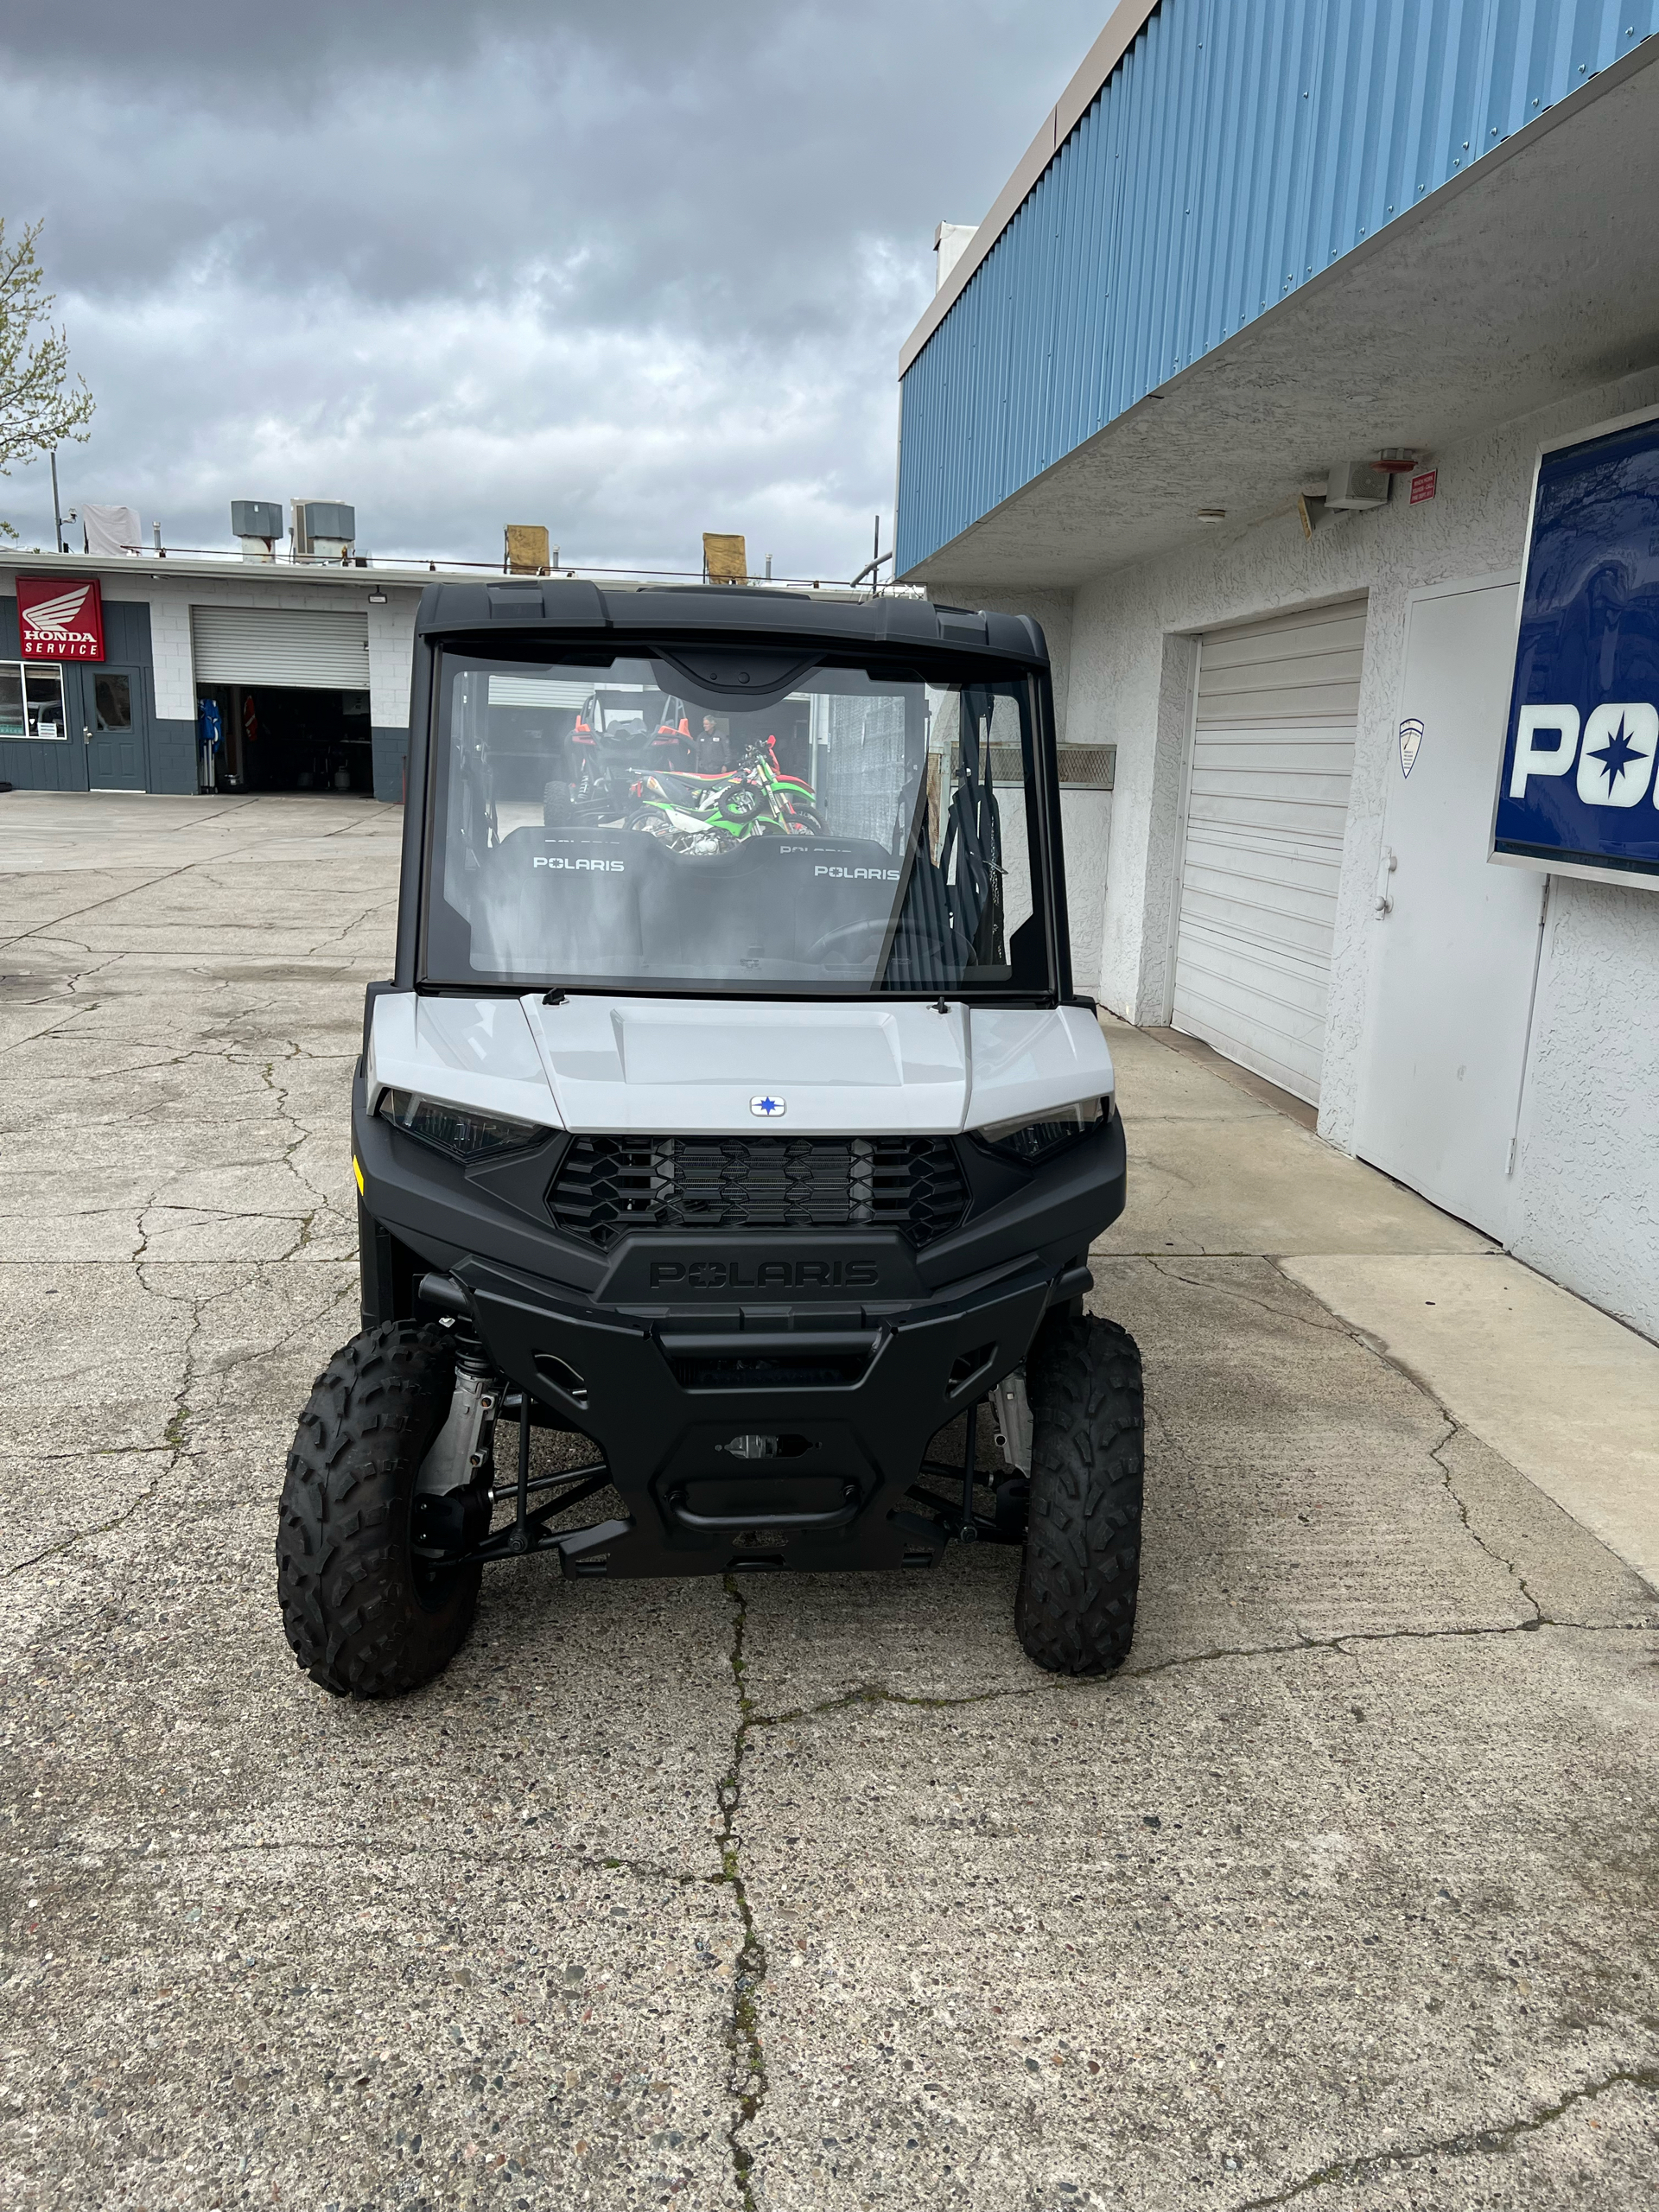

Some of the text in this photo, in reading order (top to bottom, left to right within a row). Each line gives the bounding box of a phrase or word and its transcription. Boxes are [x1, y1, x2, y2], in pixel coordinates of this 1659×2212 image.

[23, 630, 97, 642] HONDA
[25, 642, 98, 655] SERVICE
[1510, 702, 1659, 810] PO
[533, 856, 625, 872] POLARIS
[814, 865, 900, 880] POLARIS
[650, 1262, 879, 1289] POLARIS
